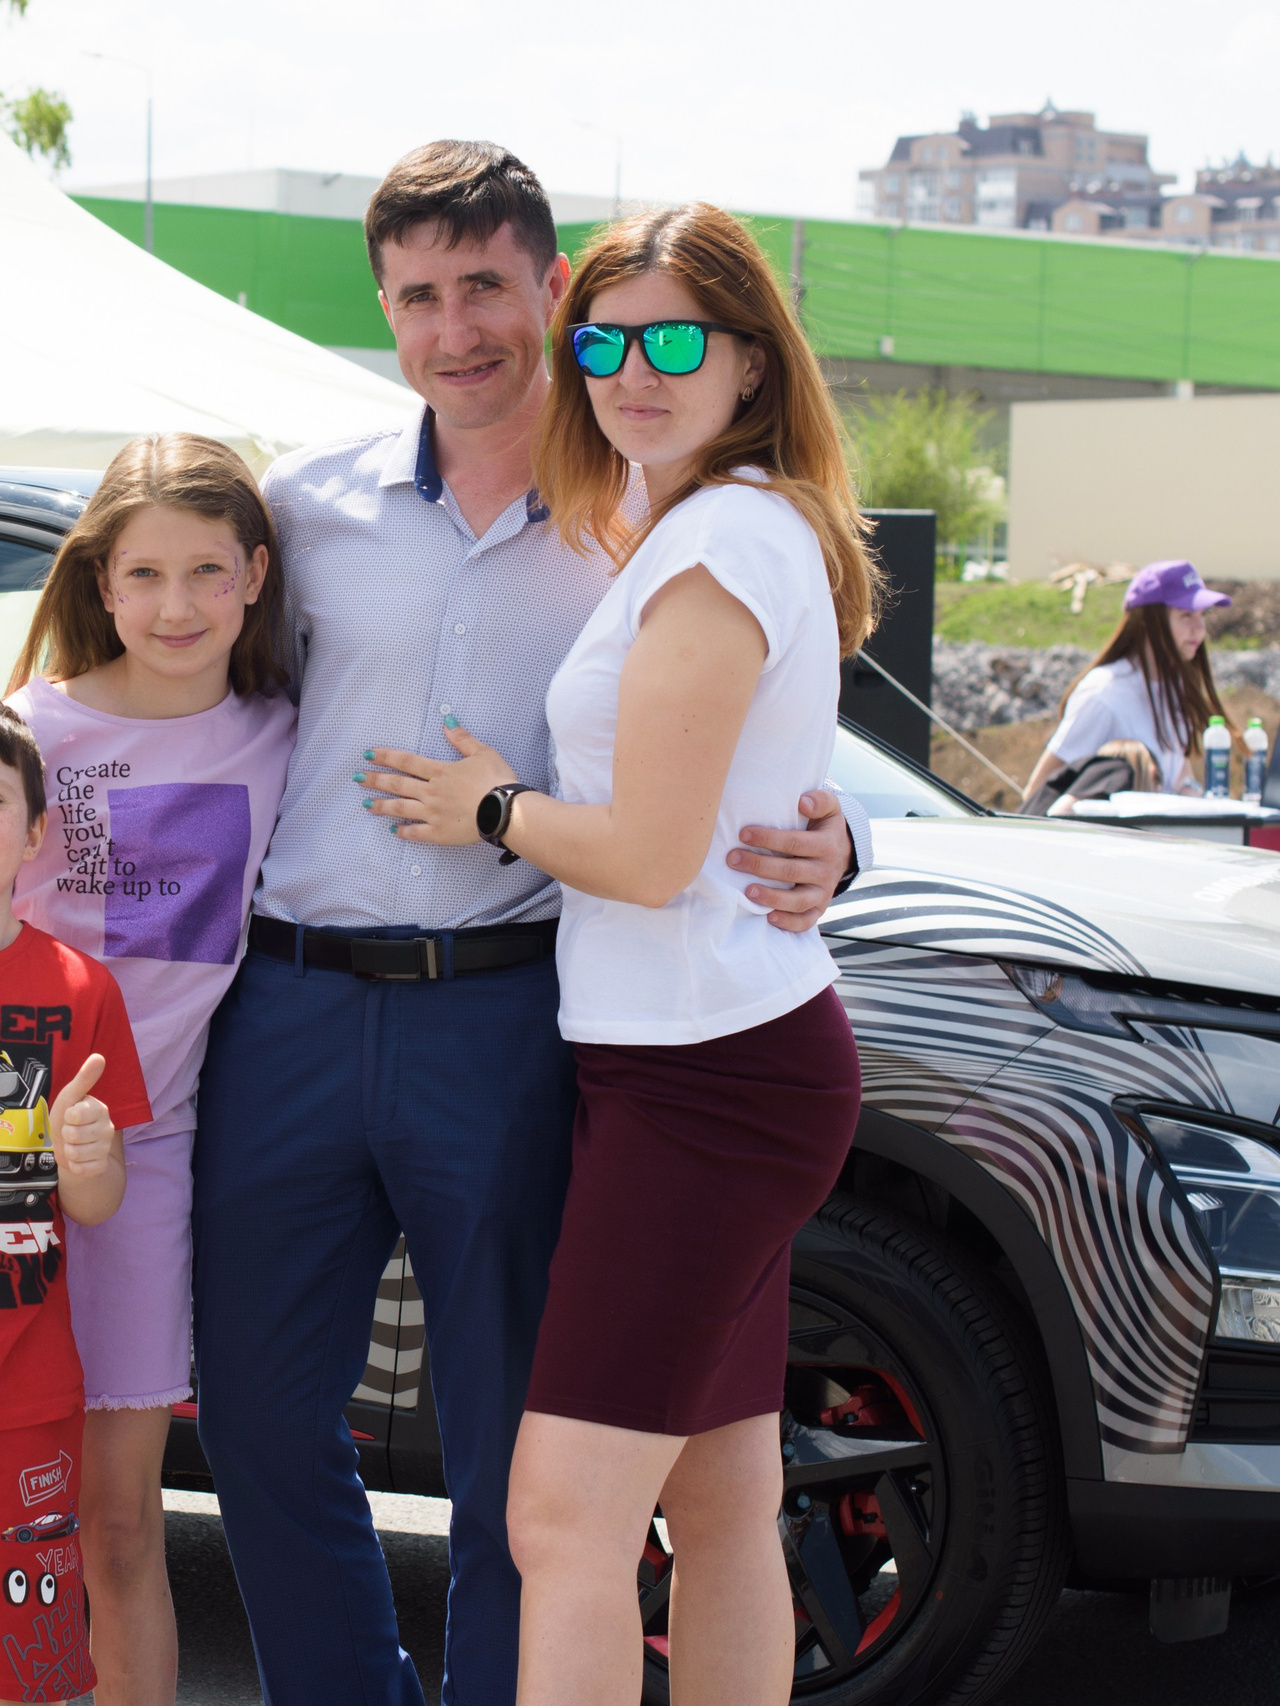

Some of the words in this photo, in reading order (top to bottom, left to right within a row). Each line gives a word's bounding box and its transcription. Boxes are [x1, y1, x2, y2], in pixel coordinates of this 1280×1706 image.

[56, 760, 131, 785] Create
[58, 802, 97, 824] life
[62, 823, 106, 849] you
[68, 854, 108, 875] ait
[113, 857, 136, 876] to
[56, 872, 116, 896] wake
[122, 879, 152, 902] up
[158, 877, 181, 896] to
[29, 1466, 62, 1491] FINISH
